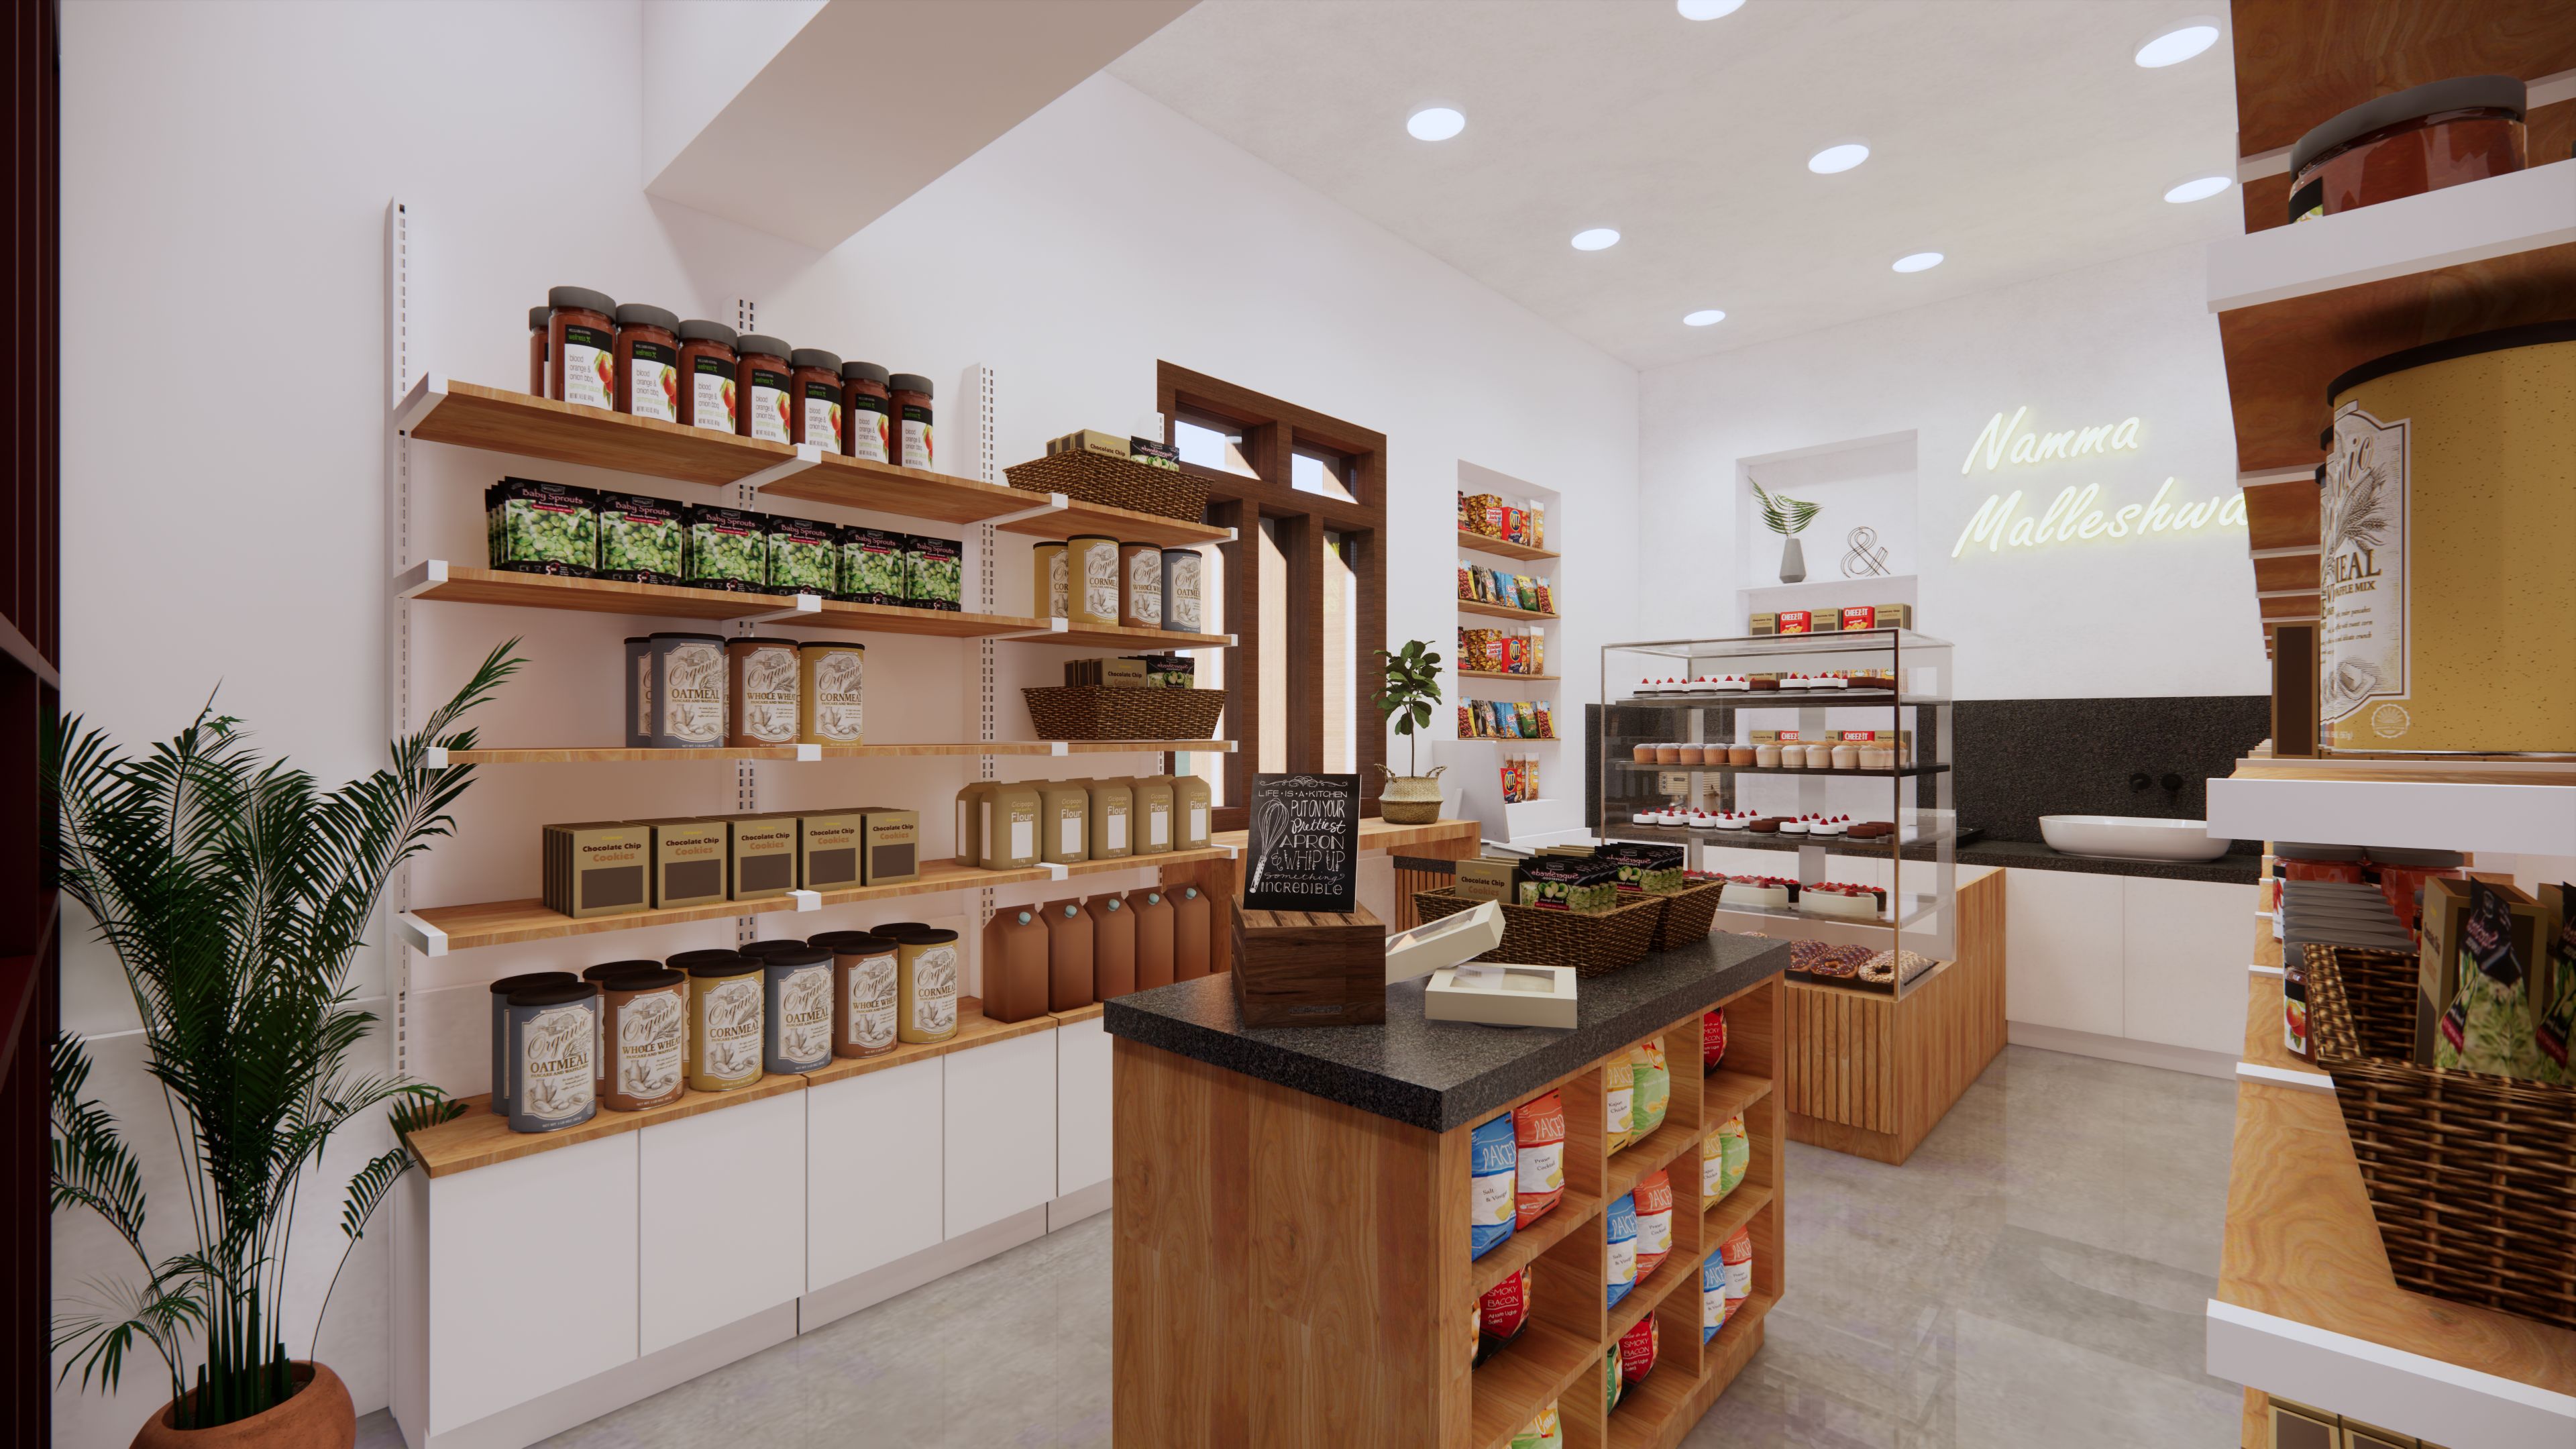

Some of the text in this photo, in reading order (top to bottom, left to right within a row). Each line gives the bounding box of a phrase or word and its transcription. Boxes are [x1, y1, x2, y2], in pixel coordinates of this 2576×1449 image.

[569, 355, 584, 363] blood
[569, 364, 586, 373] orange
[637, 369, 650, 377] blood
[637, 379, 653, 388] orange
[698, 382, 711, 390] blood
[698, 392, 714, 400] orange
[809, 416, 822, 424] orange
[1962, 405, 2140, 475] Namma
[1090, 443, 1114, 453] Chocolate
[522, 488, 546, 501] Baby
[548, 494, 584, 504] Sprouts
[615, 501, 670, 517] Baby Sprouts
[706, 514, 755, 527] Baby Sprouts
[1511, 512, 1521, 528] RITZ
[781, 524, 826, 537] Baby Sprouts
[855, 534, 896, 547] Baby Sprouts
[916, 543, 955, 555] Baby Sprouts
[2336, 580, 2376, 597] AFFLE MIX
[1782, 612, 1803, 621] CHEEZ-IT
[1845, 608, 1868, 617] CHEEZ-IT
[1510, 644, 1521, 659] RITZ
[669, 655, 719, 688] Organic
[747, 659, 794, 689] Organic
[672, 689, 720, 699] OATMEAL
[747, 692, 775, 700] WHOLE
[820, 693, 861, 702] CORNMEAL
[1505, 774, 1515, 787] RITZ
[1108, 806, 1126, 815] Flour
[1150, 804, 1168, 812] Flour
[1190, 801, 1207, 809] Flour
[1291, 800, 1345, 818] PUT ON YOUR
[1012, 812, 1034, 822] Flour
[1061, 809, 1082, 818] Flour
[1291, 818, 1346, 834] Prettiest
[741, 833, 774, 841] Chocolate
[818, 837, 849, 845] Cookies
[1279, 835, 1344, 849] APRON
[582, 844, 623, 852] Chocolate
[665, 839, 702, 847] Chocolate
[749, 841, 784, 850] Cookies
[675, 847, 713, 855] Cookies
[593, 852, 635, 862] Cookies
[1284, 850, 1322, 870] WHIP
[1326, 850, 1345, 871] UP
[1265, 872, 1344, 885] something
[1461, 876, 1505, 888] Chocolate Chip
[1468, 886, 1499, 897] Cookies
[918, 983, 956, 998] CORNMEAL
[708, 987, 757, 1025] Organic
[853, 1000, 879, 1010] WHOLE
[786, 1006, 828, 1024] OATMEAL
[623, 1001, 678, 1042] Organic
[710, 1020, 759, 1038] CORNMEAL
[528, 1016, 587, 1061] Organic
[623, 1036, 681, 1055] WHOLE WHEAT
[530, 1052, 588, 1073] OATMEAL
[1483, 1188, 1494, 1196] Salt
[1488, 1285, 1517, 1297] SMOKY
[1488, 1295, 1519, 1307] BACON
[1624, 1338, 1649, 1348] SMOKY
[1623, 1346, 1650, 1356] BACON
